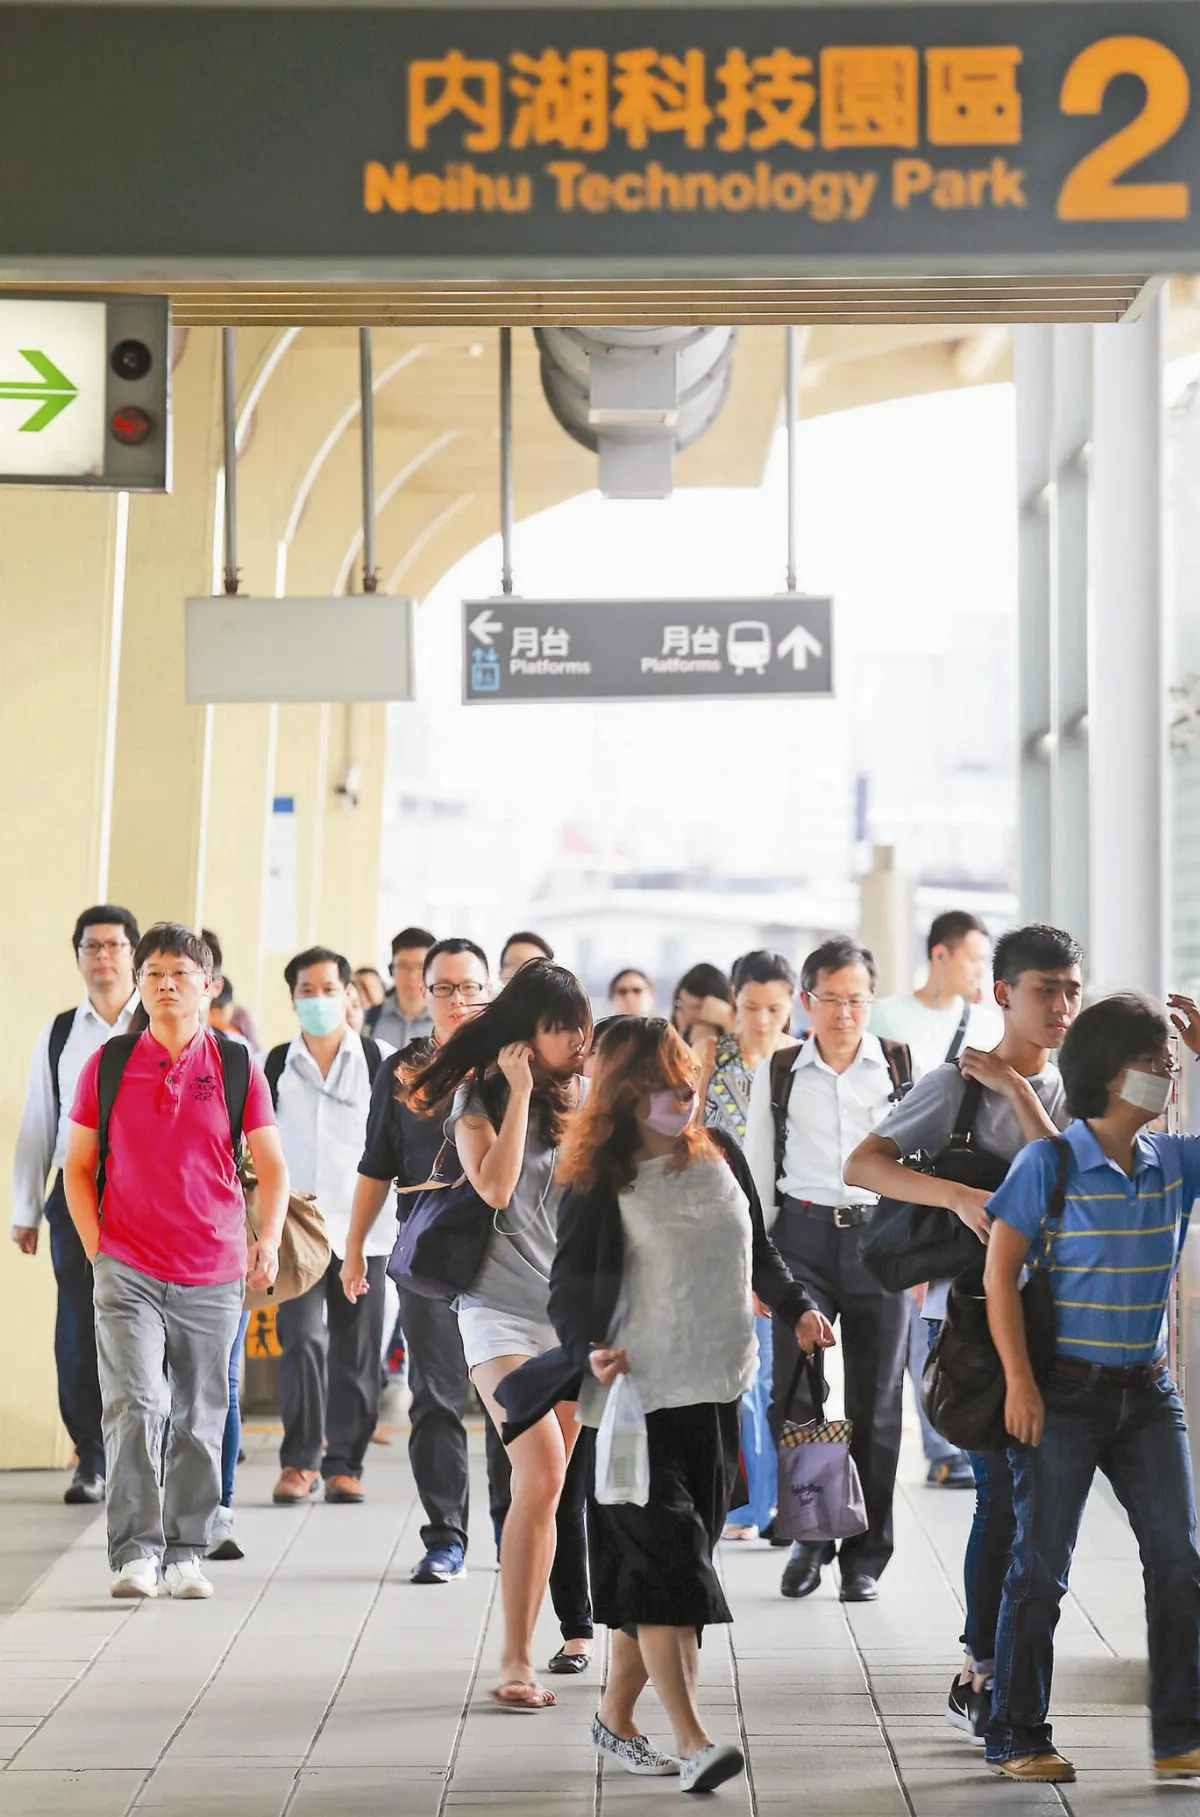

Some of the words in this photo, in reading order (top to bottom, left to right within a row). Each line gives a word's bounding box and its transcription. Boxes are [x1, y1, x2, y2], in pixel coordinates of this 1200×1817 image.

[1058, 35, 1190, 221] 2
[363, 161, 532, 214] Neihu
[547, 161, 876, 219] Technology
[892, 159, 1025, 208] Park
[510, 626, 571, 658] 月台
[661, 625, 721, 656] 月台
[509, 659, 592, 676] Platforms
[640, 657, 722, 674] Platforms
